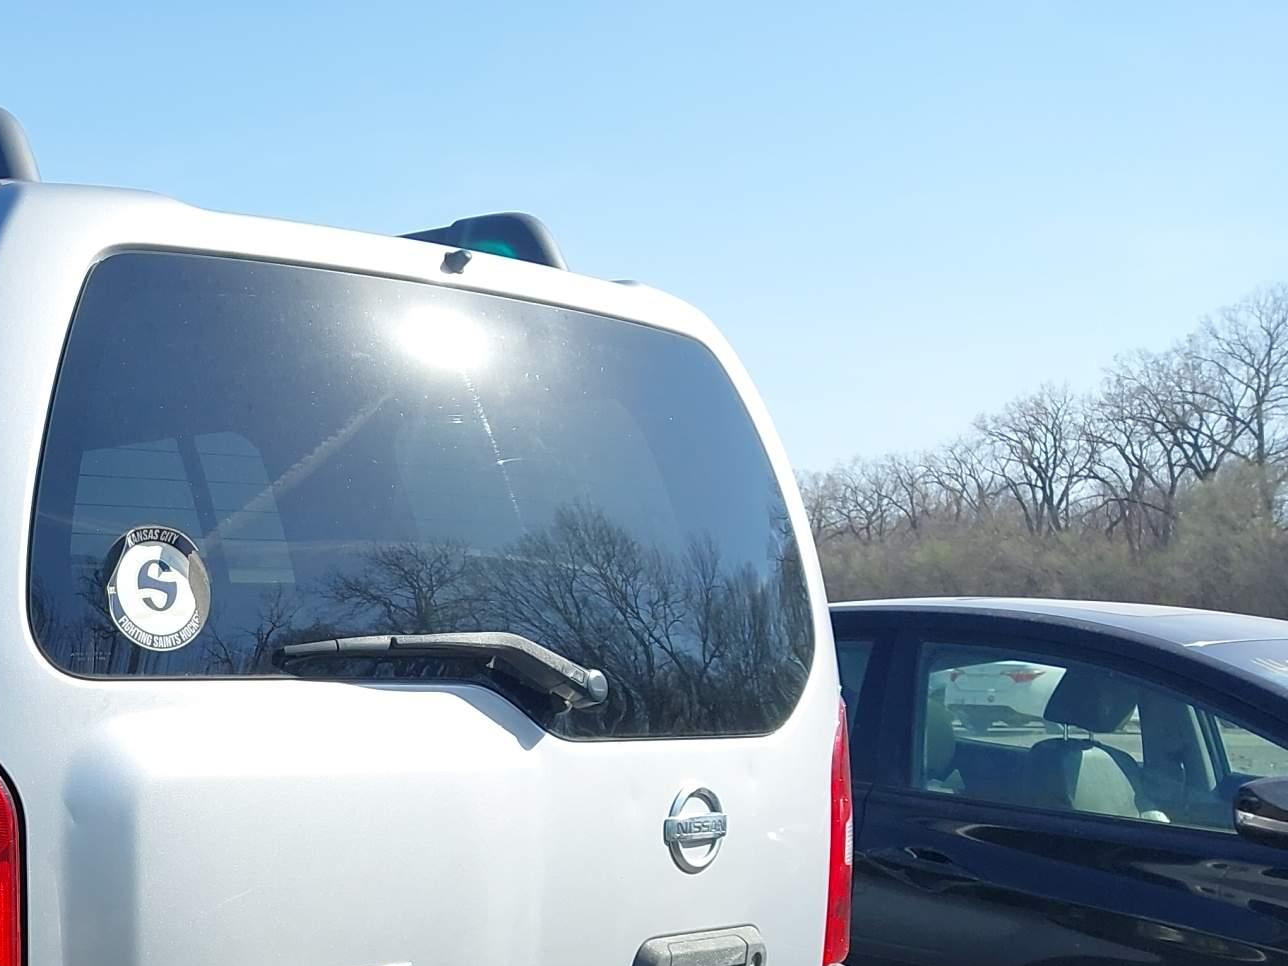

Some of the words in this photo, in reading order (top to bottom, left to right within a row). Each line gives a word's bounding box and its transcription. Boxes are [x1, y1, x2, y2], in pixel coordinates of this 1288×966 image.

[126, 529, 159, 548] KANSAS
[160, 530, 180, 545] CITY
[137, 559, 178, 612] S
[118, 615, 153, 647] FIGHTING
[153, 634, 182, 648] SAINTS
[676, 819, 724, 835] NISSAN
